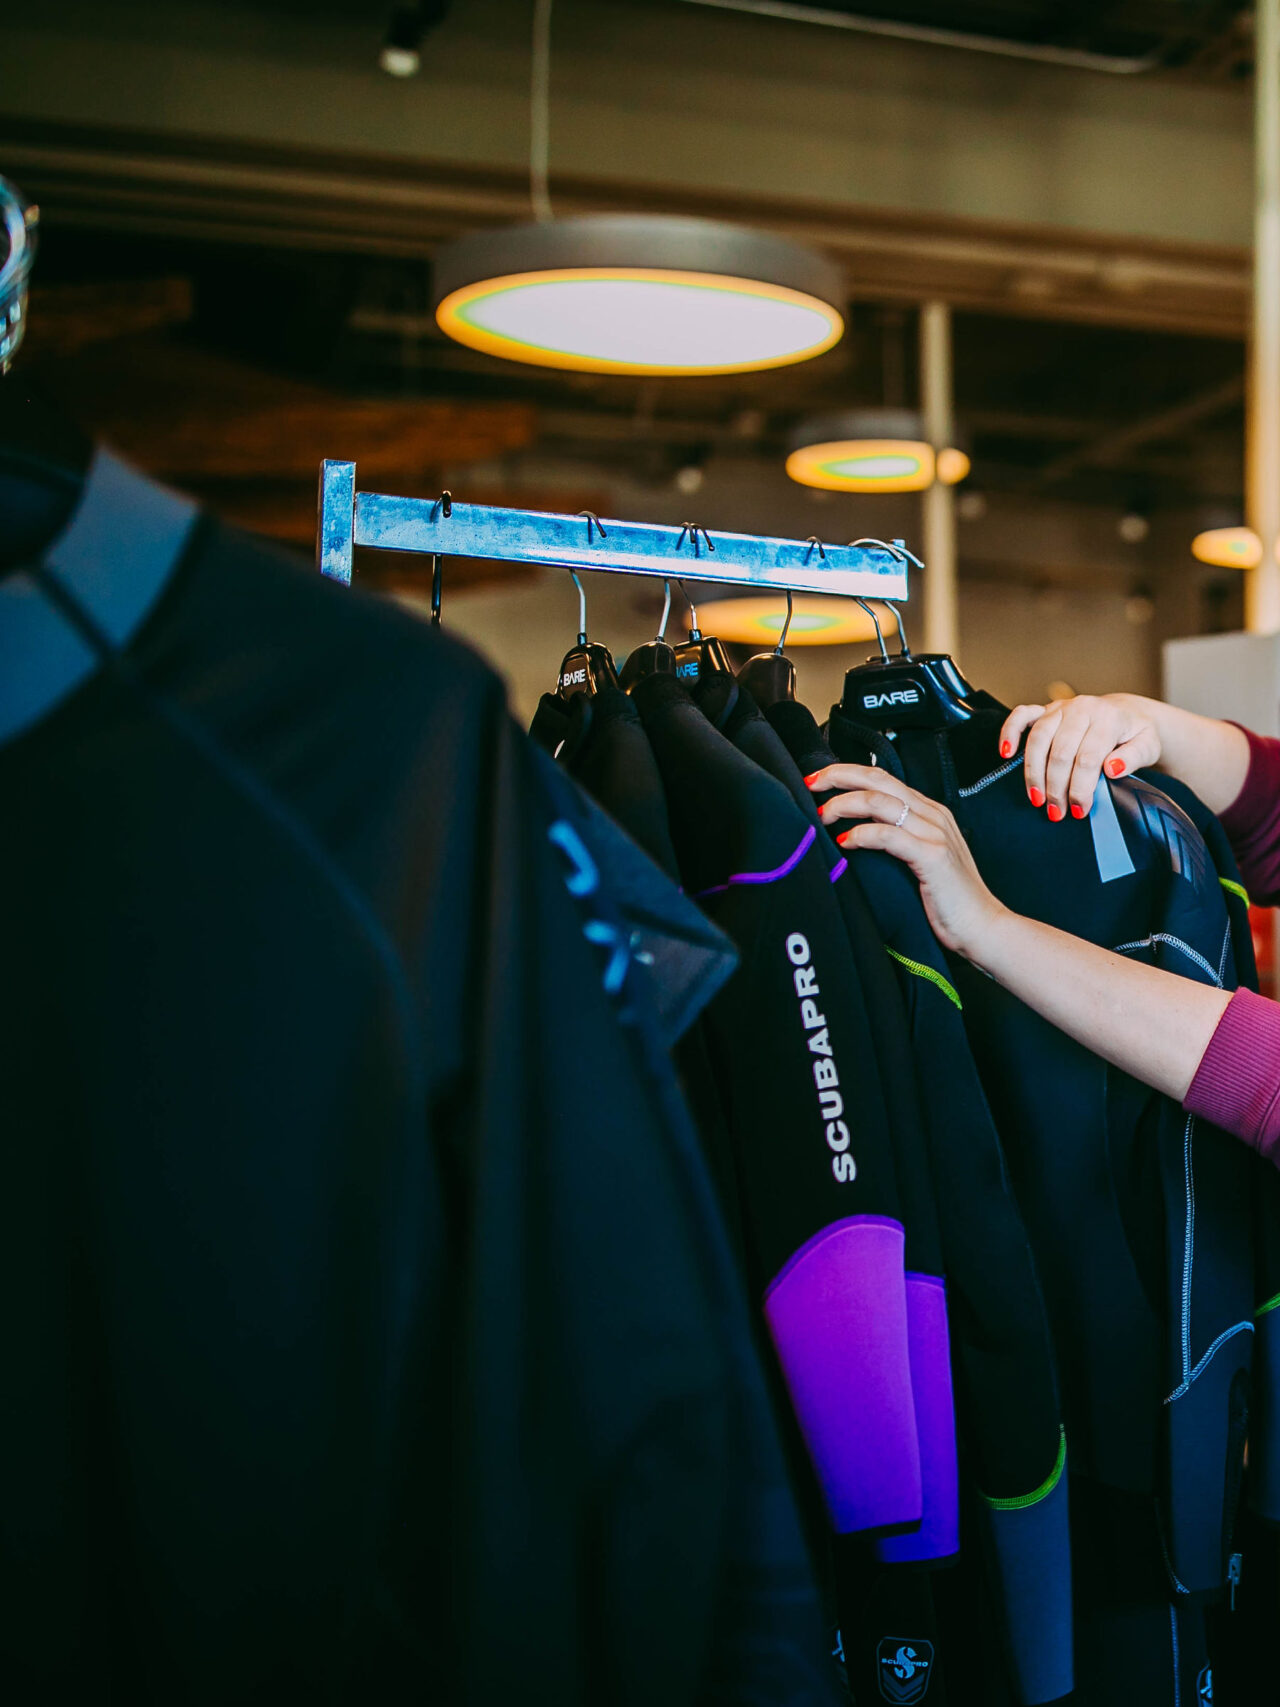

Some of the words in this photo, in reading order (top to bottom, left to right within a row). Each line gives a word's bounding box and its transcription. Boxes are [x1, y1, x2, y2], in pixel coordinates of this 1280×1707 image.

[563, 668, 587, 687] BARE
[863, 689, 919, 709] BARE
[786, 932, 857, 1183] SCUBAPRO
